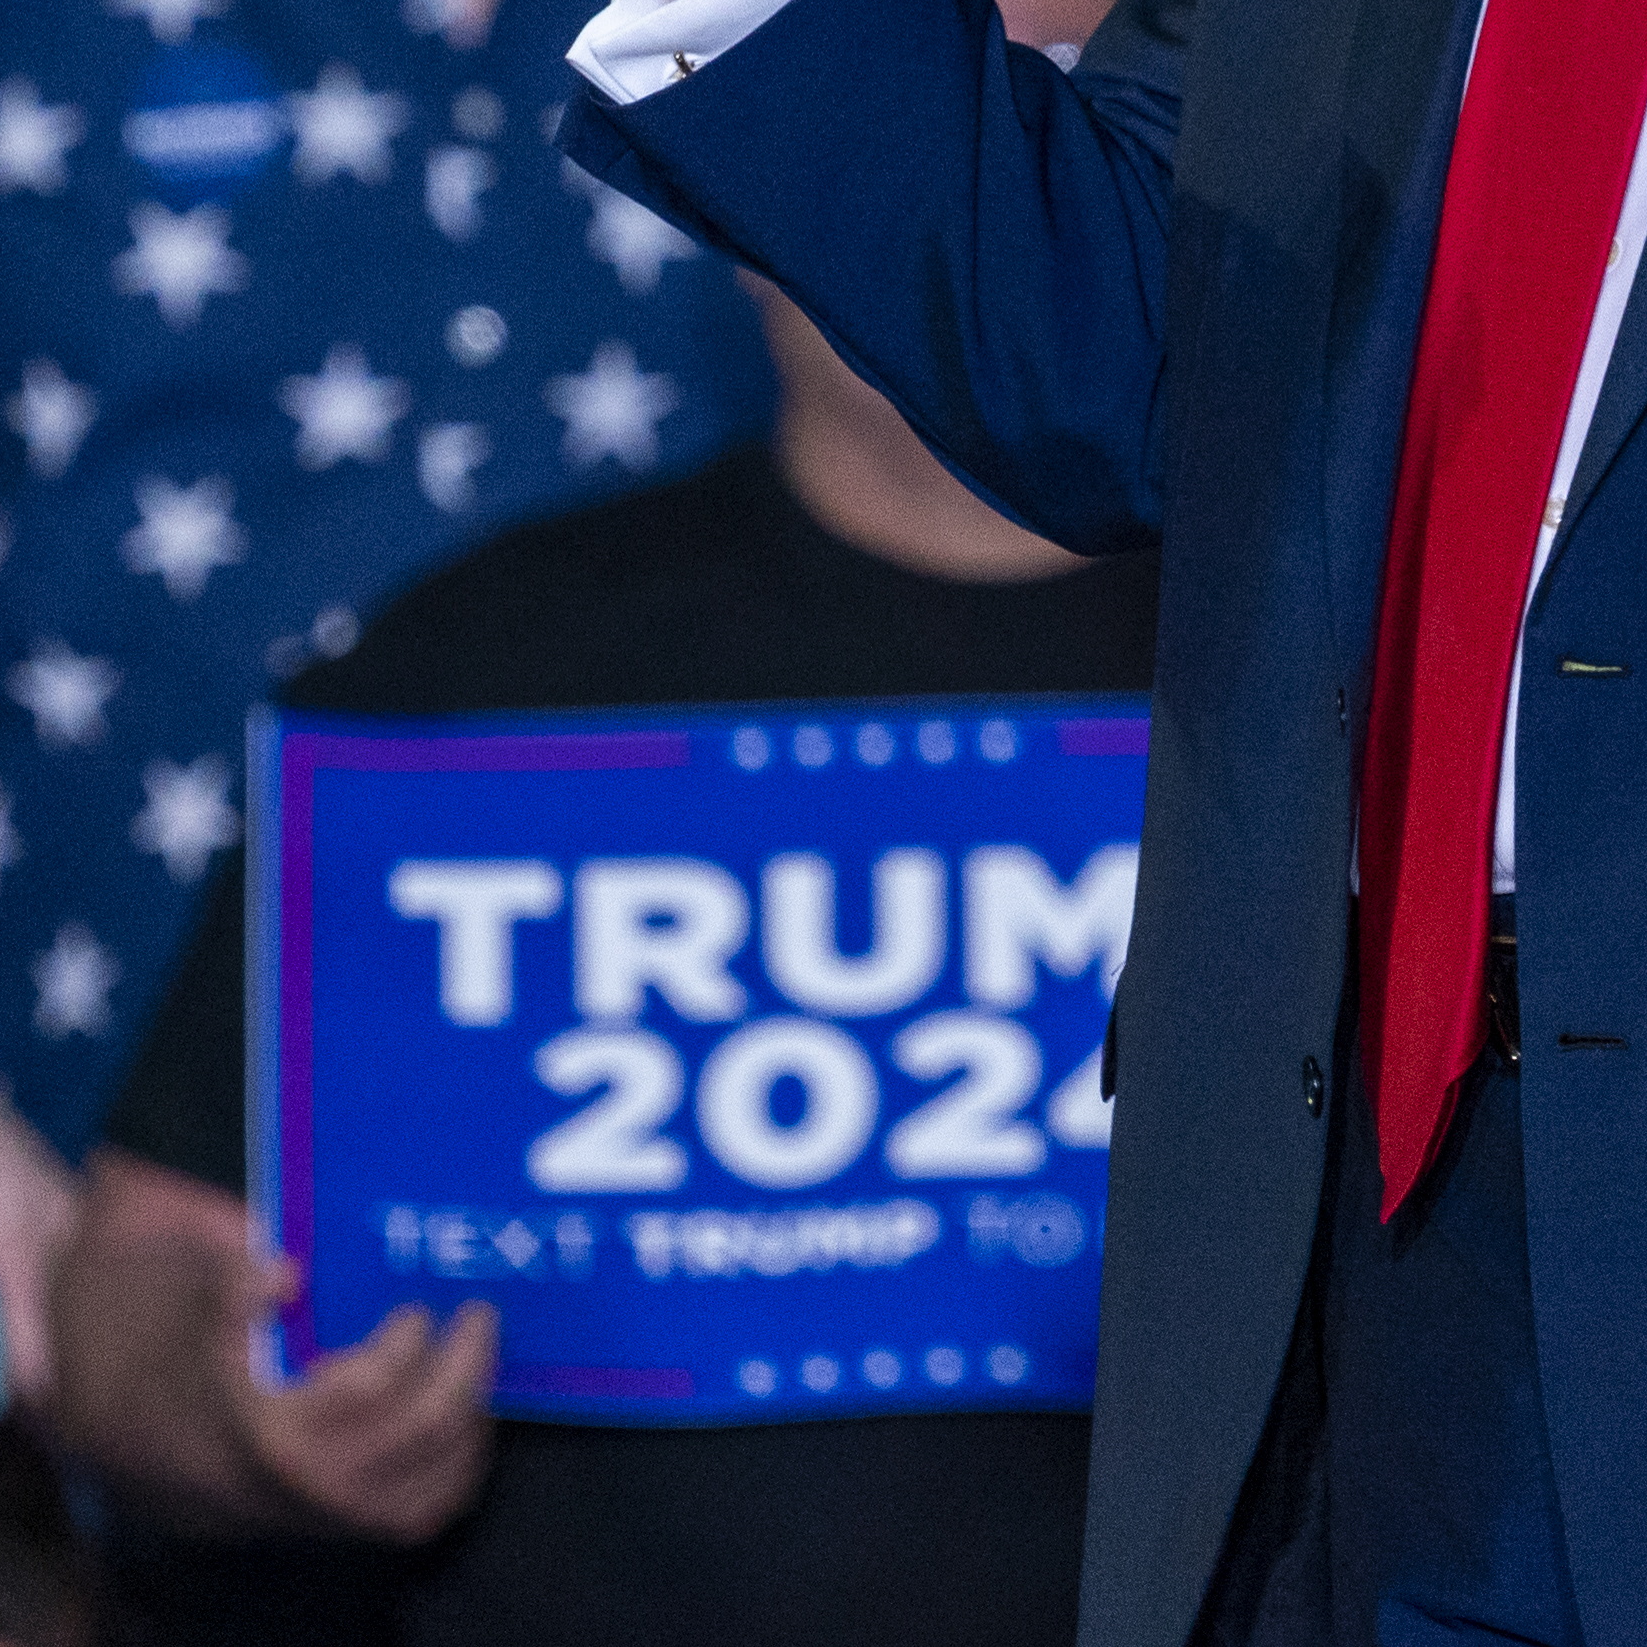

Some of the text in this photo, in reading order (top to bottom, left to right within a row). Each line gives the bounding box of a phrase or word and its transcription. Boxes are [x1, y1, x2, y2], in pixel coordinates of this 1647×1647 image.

[388, 842, 1141, 1028] TRUM
[382, 1194, 1087, 1280] TEXT TRUMP TO
